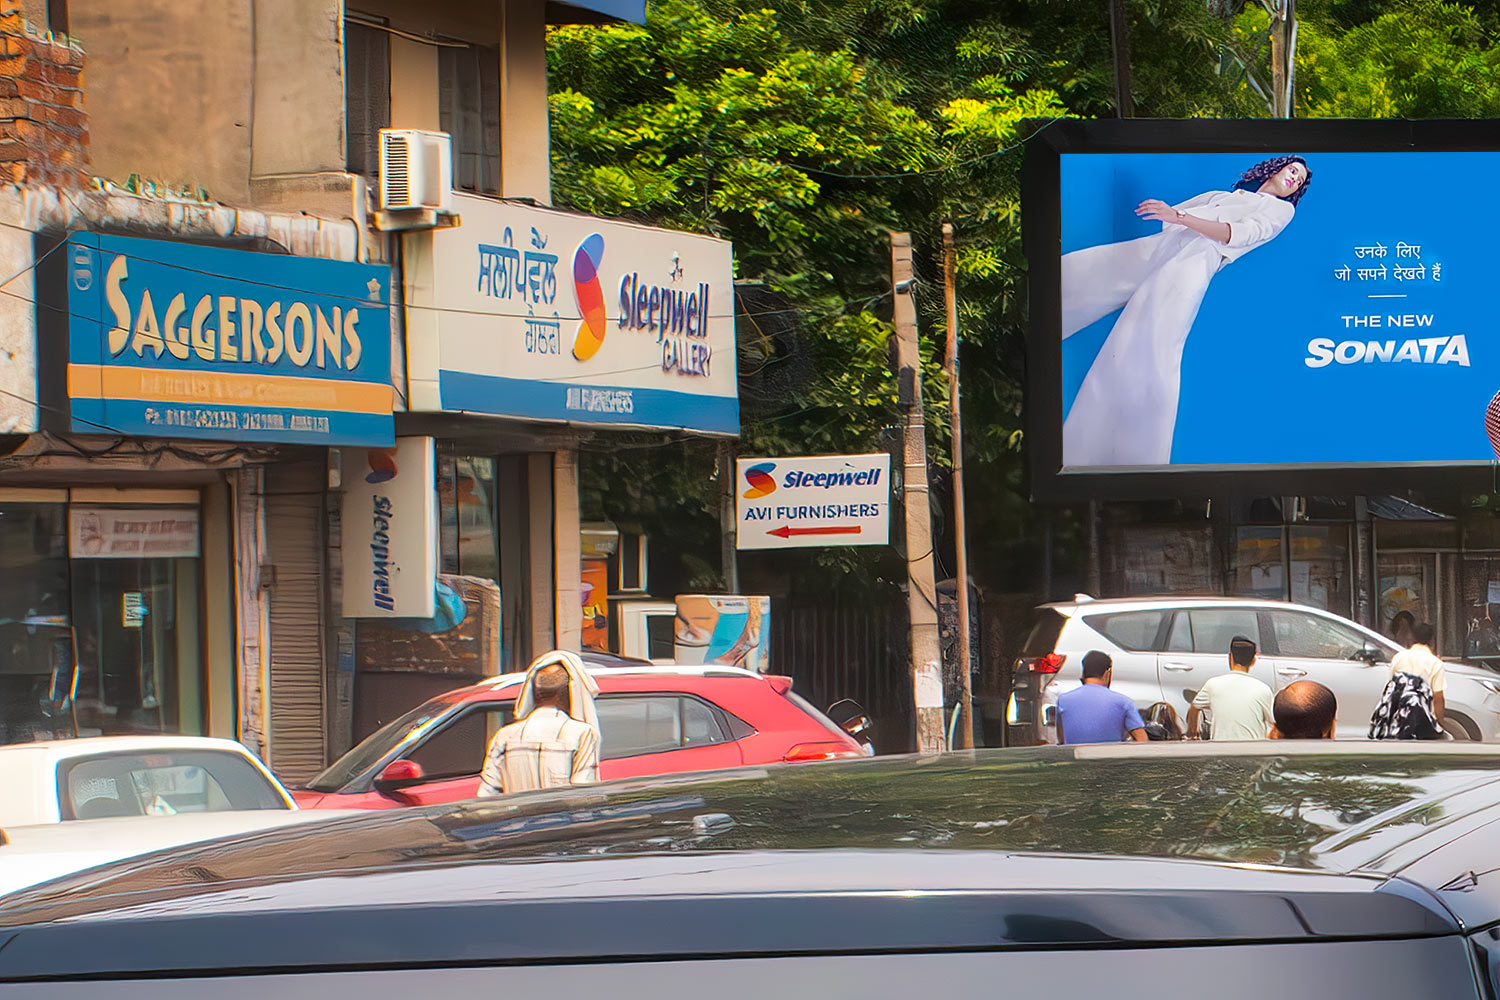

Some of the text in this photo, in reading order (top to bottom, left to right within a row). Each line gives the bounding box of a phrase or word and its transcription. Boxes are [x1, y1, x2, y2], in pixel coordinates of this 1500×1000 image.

[1354, 241, 1421, 259] उनके लिए
[1334, 262, 1442, 282] जो सपने देखते हैं
[105, 254, 363, 371] SAGGERSONS
[617, 272, 709, 343] Sleepwell
[1341, 314, 1434, 328] THE NEW
[662, 339, 712, 377] GALLERY
[1304, 334, 1471, 368] SONATA
[783, 468, 881, 489] Sleepwell
[744, 503, 879, 521] AVI FURNISHERS
